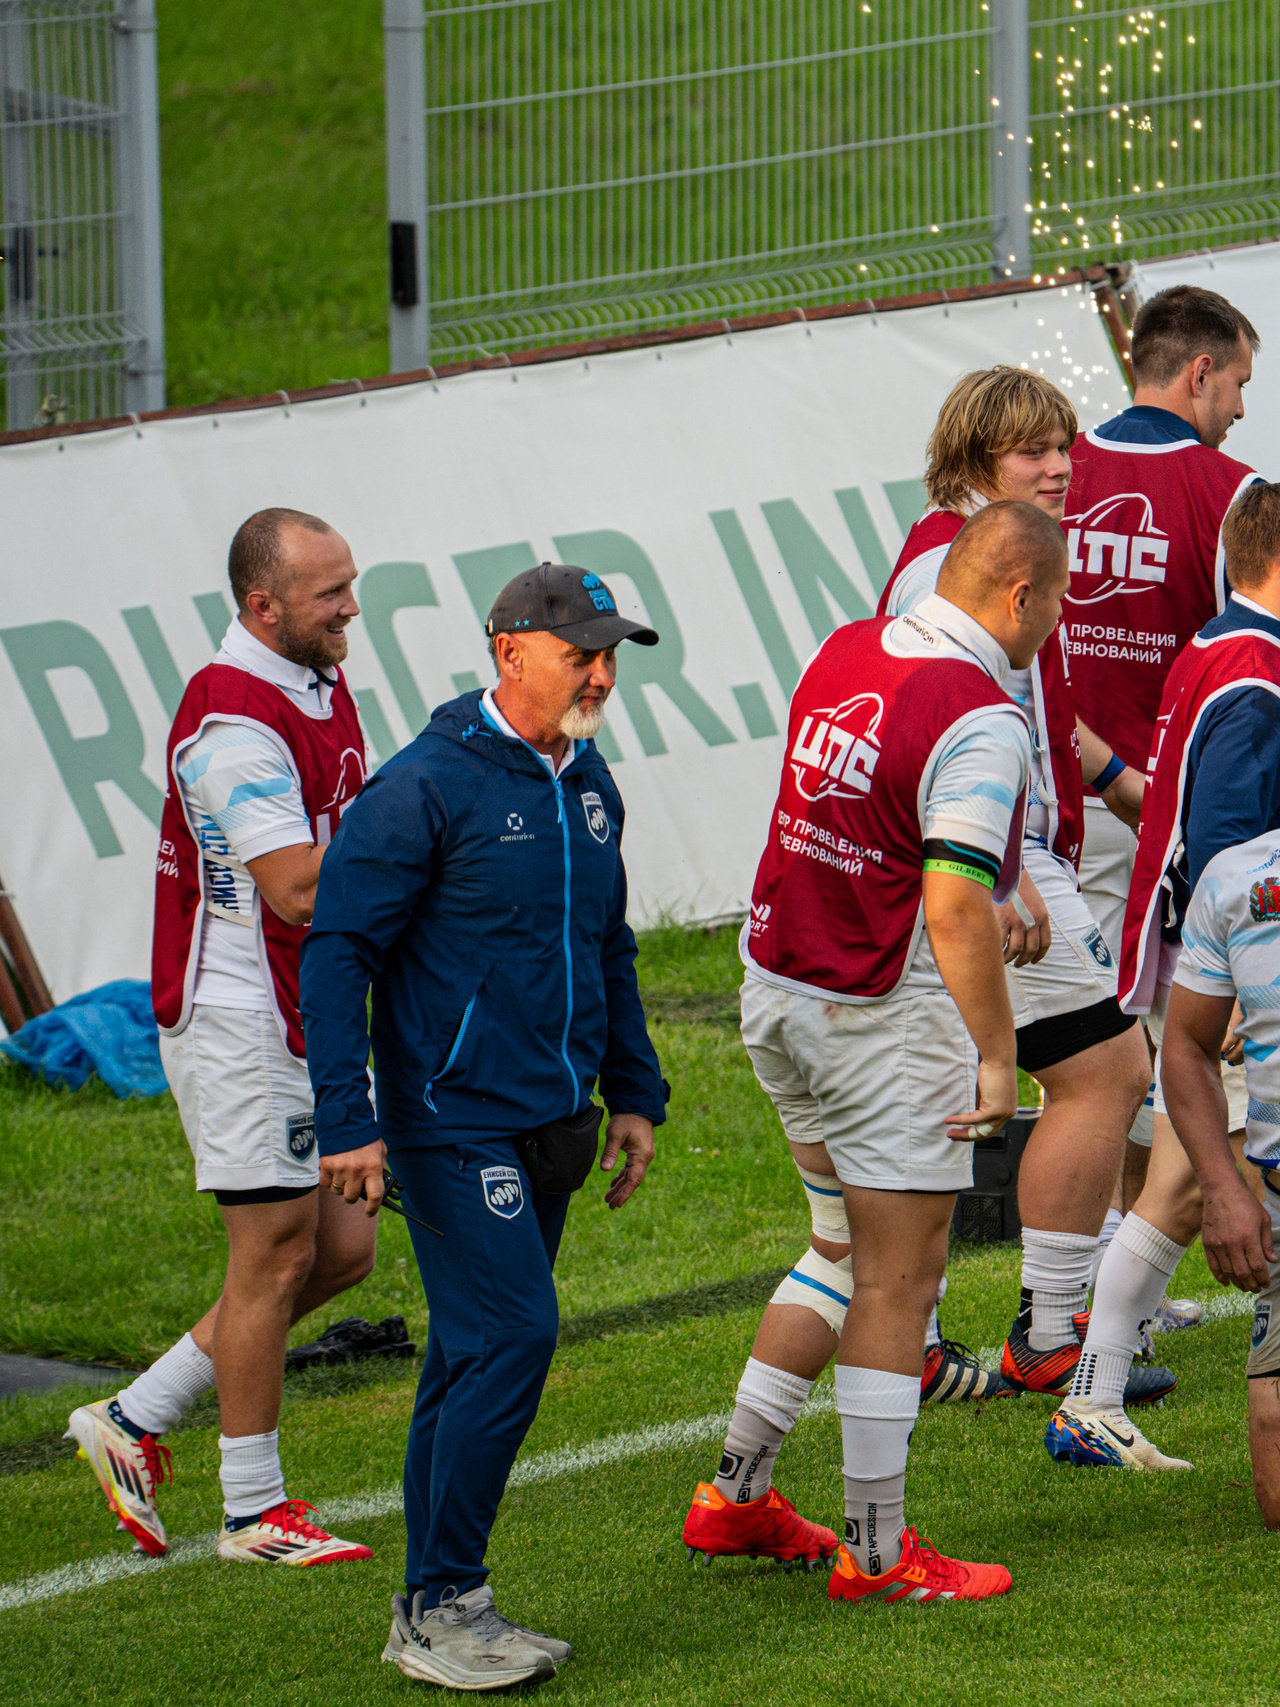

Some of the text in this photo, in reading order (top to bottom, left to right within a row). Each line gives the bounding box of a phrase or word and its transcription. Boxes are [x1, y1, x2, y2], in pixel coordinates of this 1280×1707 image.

[902, 614, 935, 646] centurion
[1070, 623, 1177, 648] ПРОВЕДЕНИЯ
[790, 715, 881, 795] ЦПС
[499, 832, 535, 842] centurion
[792, 817, 883, 865] ПРОВЕДЕНИЯ
[948, 863, 987, 880] GILBERT
[750, 919, 770, 933] ORT
[484, 1168, 507, 1179] ЕНИСЕЙ
[741, 1444, 769, 1490] TAPEDESIGN
[867, 1502, 878, 1557] TAPEDESIGN
